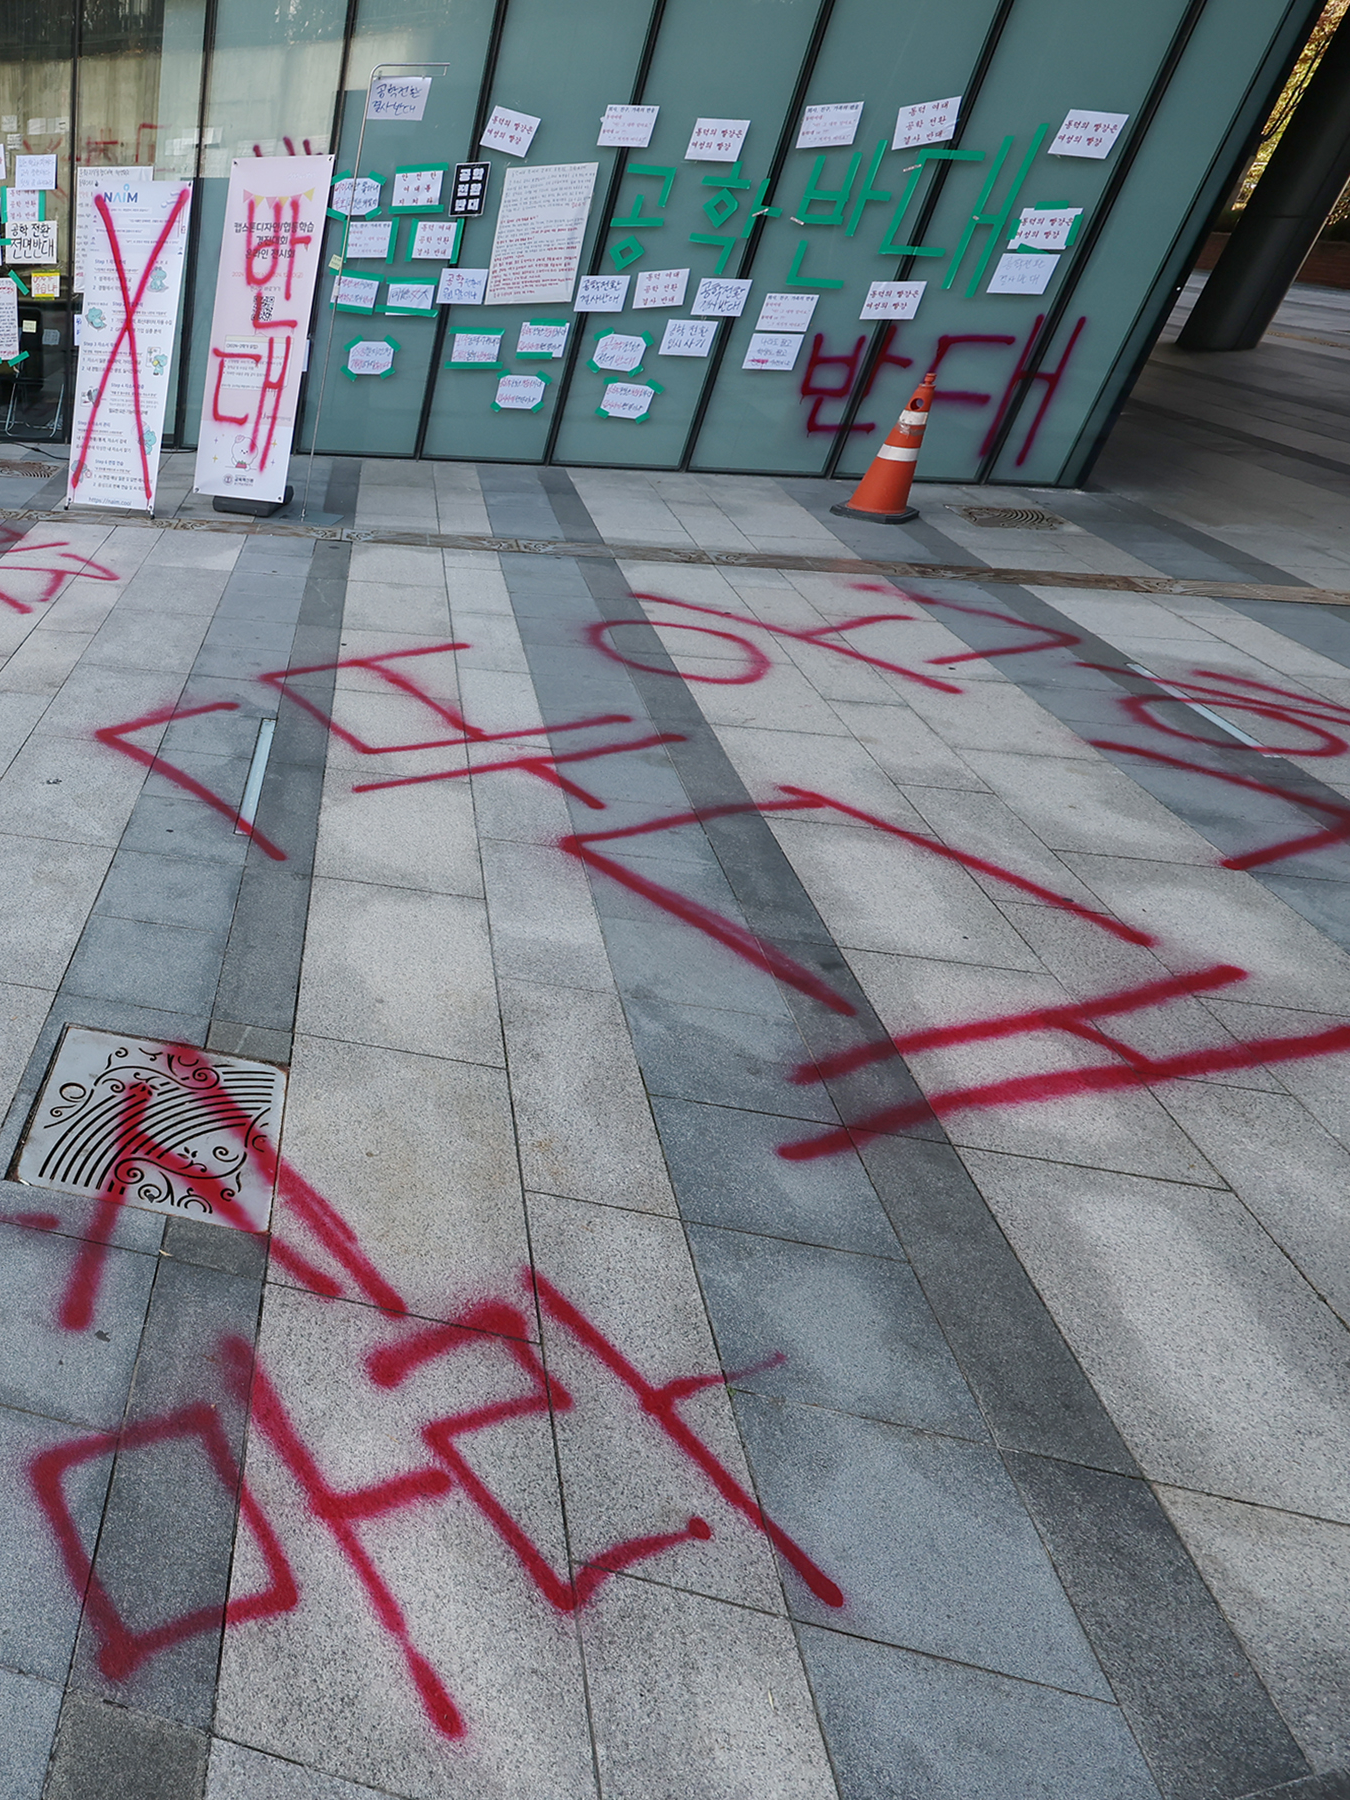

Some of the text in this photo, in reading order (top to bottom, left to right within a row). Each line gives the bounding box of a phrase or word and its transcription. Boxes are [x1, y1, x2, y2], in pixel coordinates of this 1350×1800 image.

[1065, 119, 1090, 130] 동덕의
[1057, 133, 1083, 144] 여성의
[104, 184, 139, 203] NAIM
[11, 223, 51, 239] 공학 전환
[256, 235, 288, 246] 경진대회
[11, 237, 55, 260] 전면반대
[246, 248, 295, 260] 온라인 전시회
[800, 315, 1087, 466] 반대
